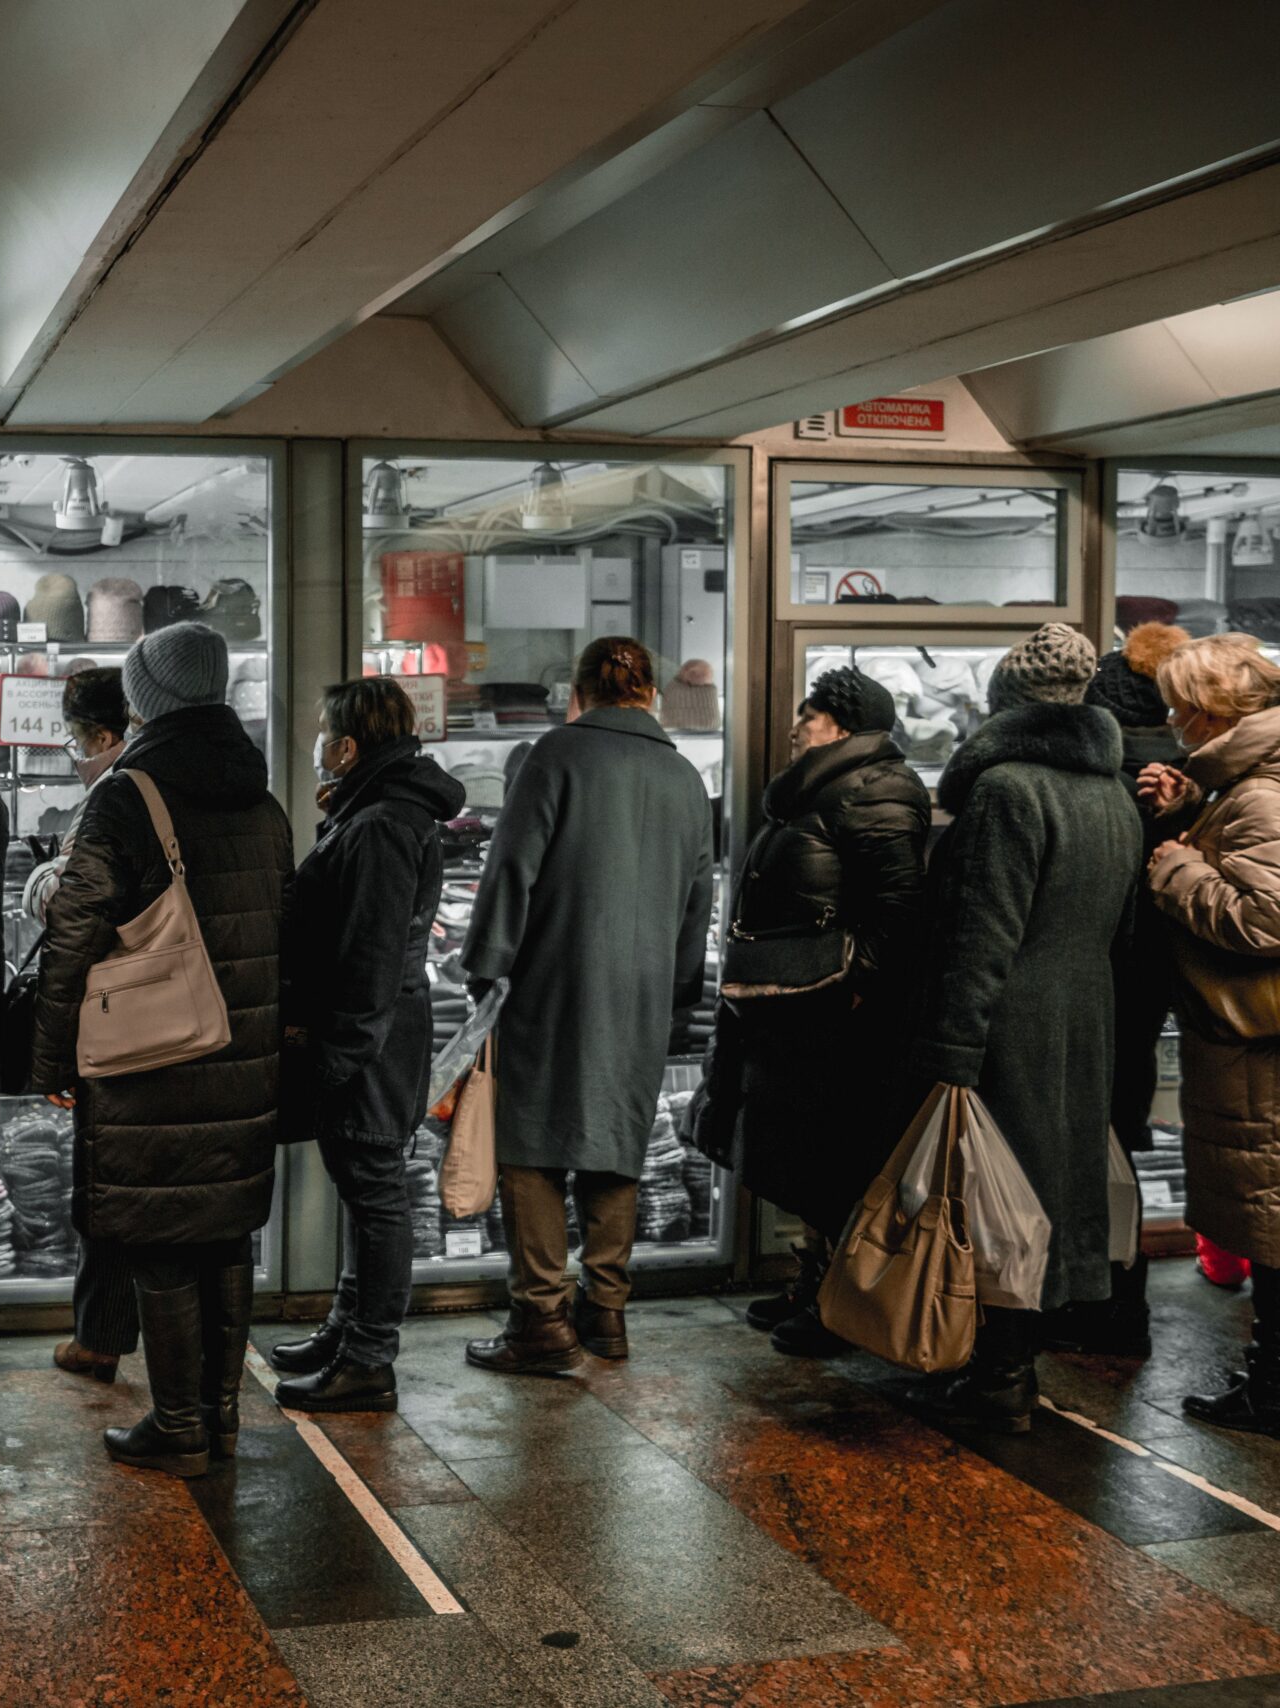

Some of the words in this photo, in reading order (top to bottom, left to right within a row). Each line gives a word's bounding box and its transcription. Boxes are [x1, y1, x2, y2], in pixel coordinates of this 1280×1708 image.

[858, 402, 931, 414] АВТОМАТИКА
[857, 414, 931, 427] ОТКЛЮЧЕНА
[16, 690, 62, 698] АССОРТИ
[9, 716, 44, 733] 144
